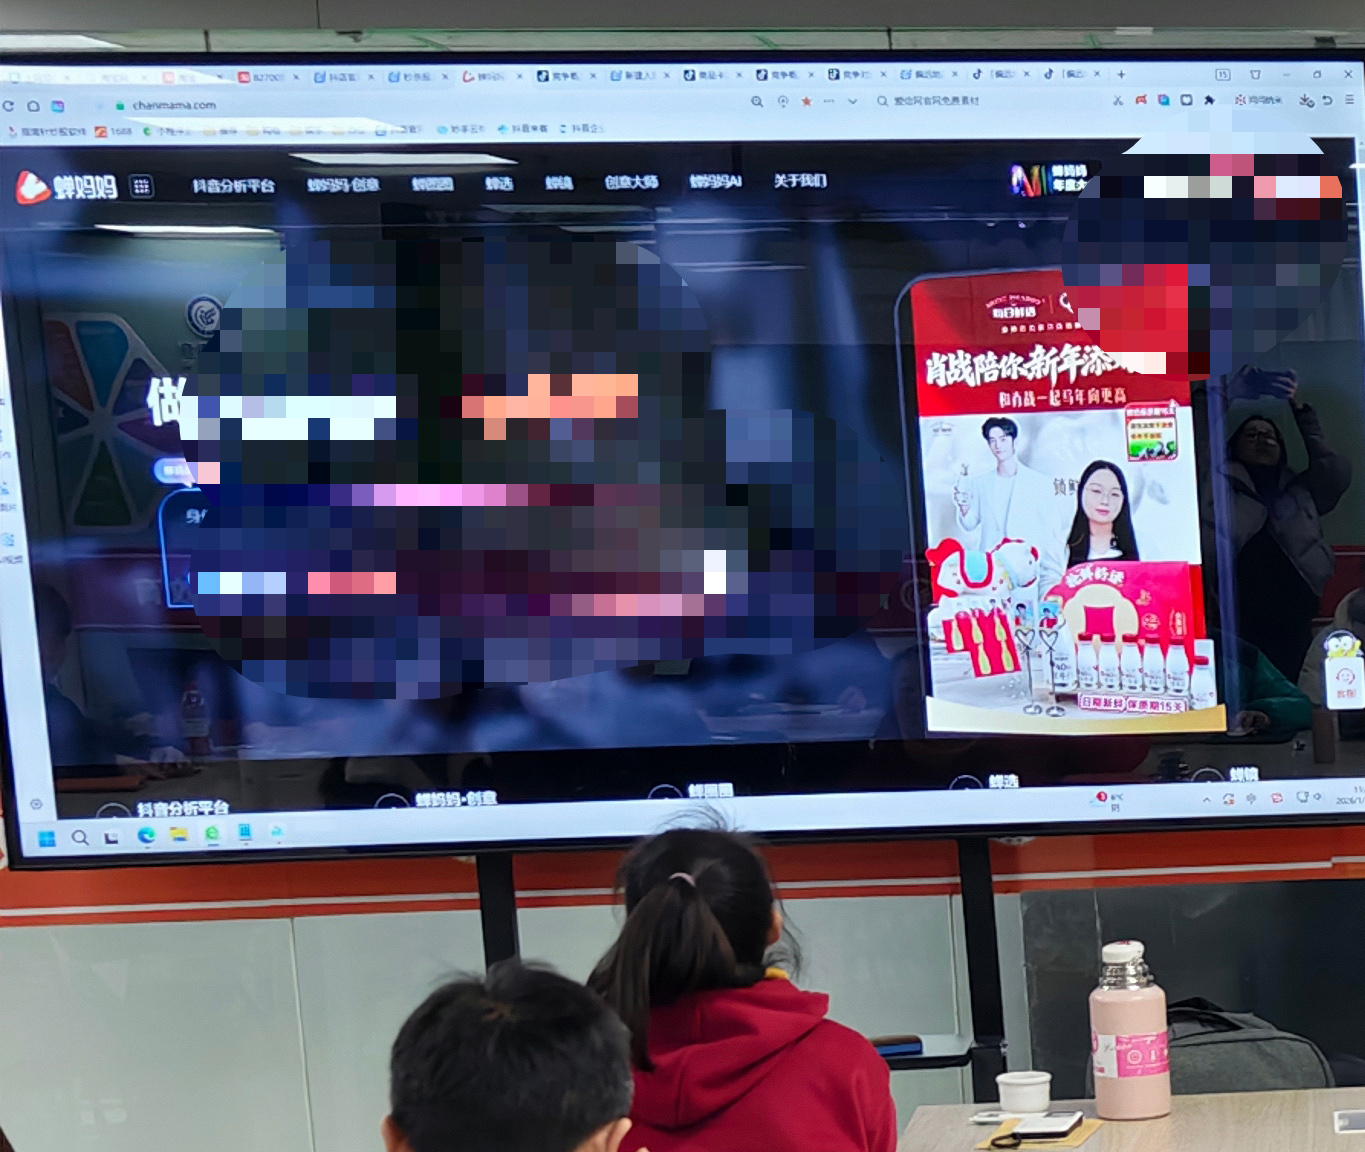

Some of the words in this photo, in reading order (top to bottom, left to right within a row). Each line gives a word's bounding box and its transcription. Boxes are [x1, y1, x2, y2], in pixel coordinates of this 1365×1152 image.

[133, 100, 216, 110] chanmama.com
[53, 174, 118, 199] 蝉妈妈
[193, 178, 275, 194] 抖音分析平台
[774, 173, 827, 188] 关于我们
[925, 342, 1144, 389] 肖战陪你新年添
[137, 799, 229, 818] 抖音分析平台
